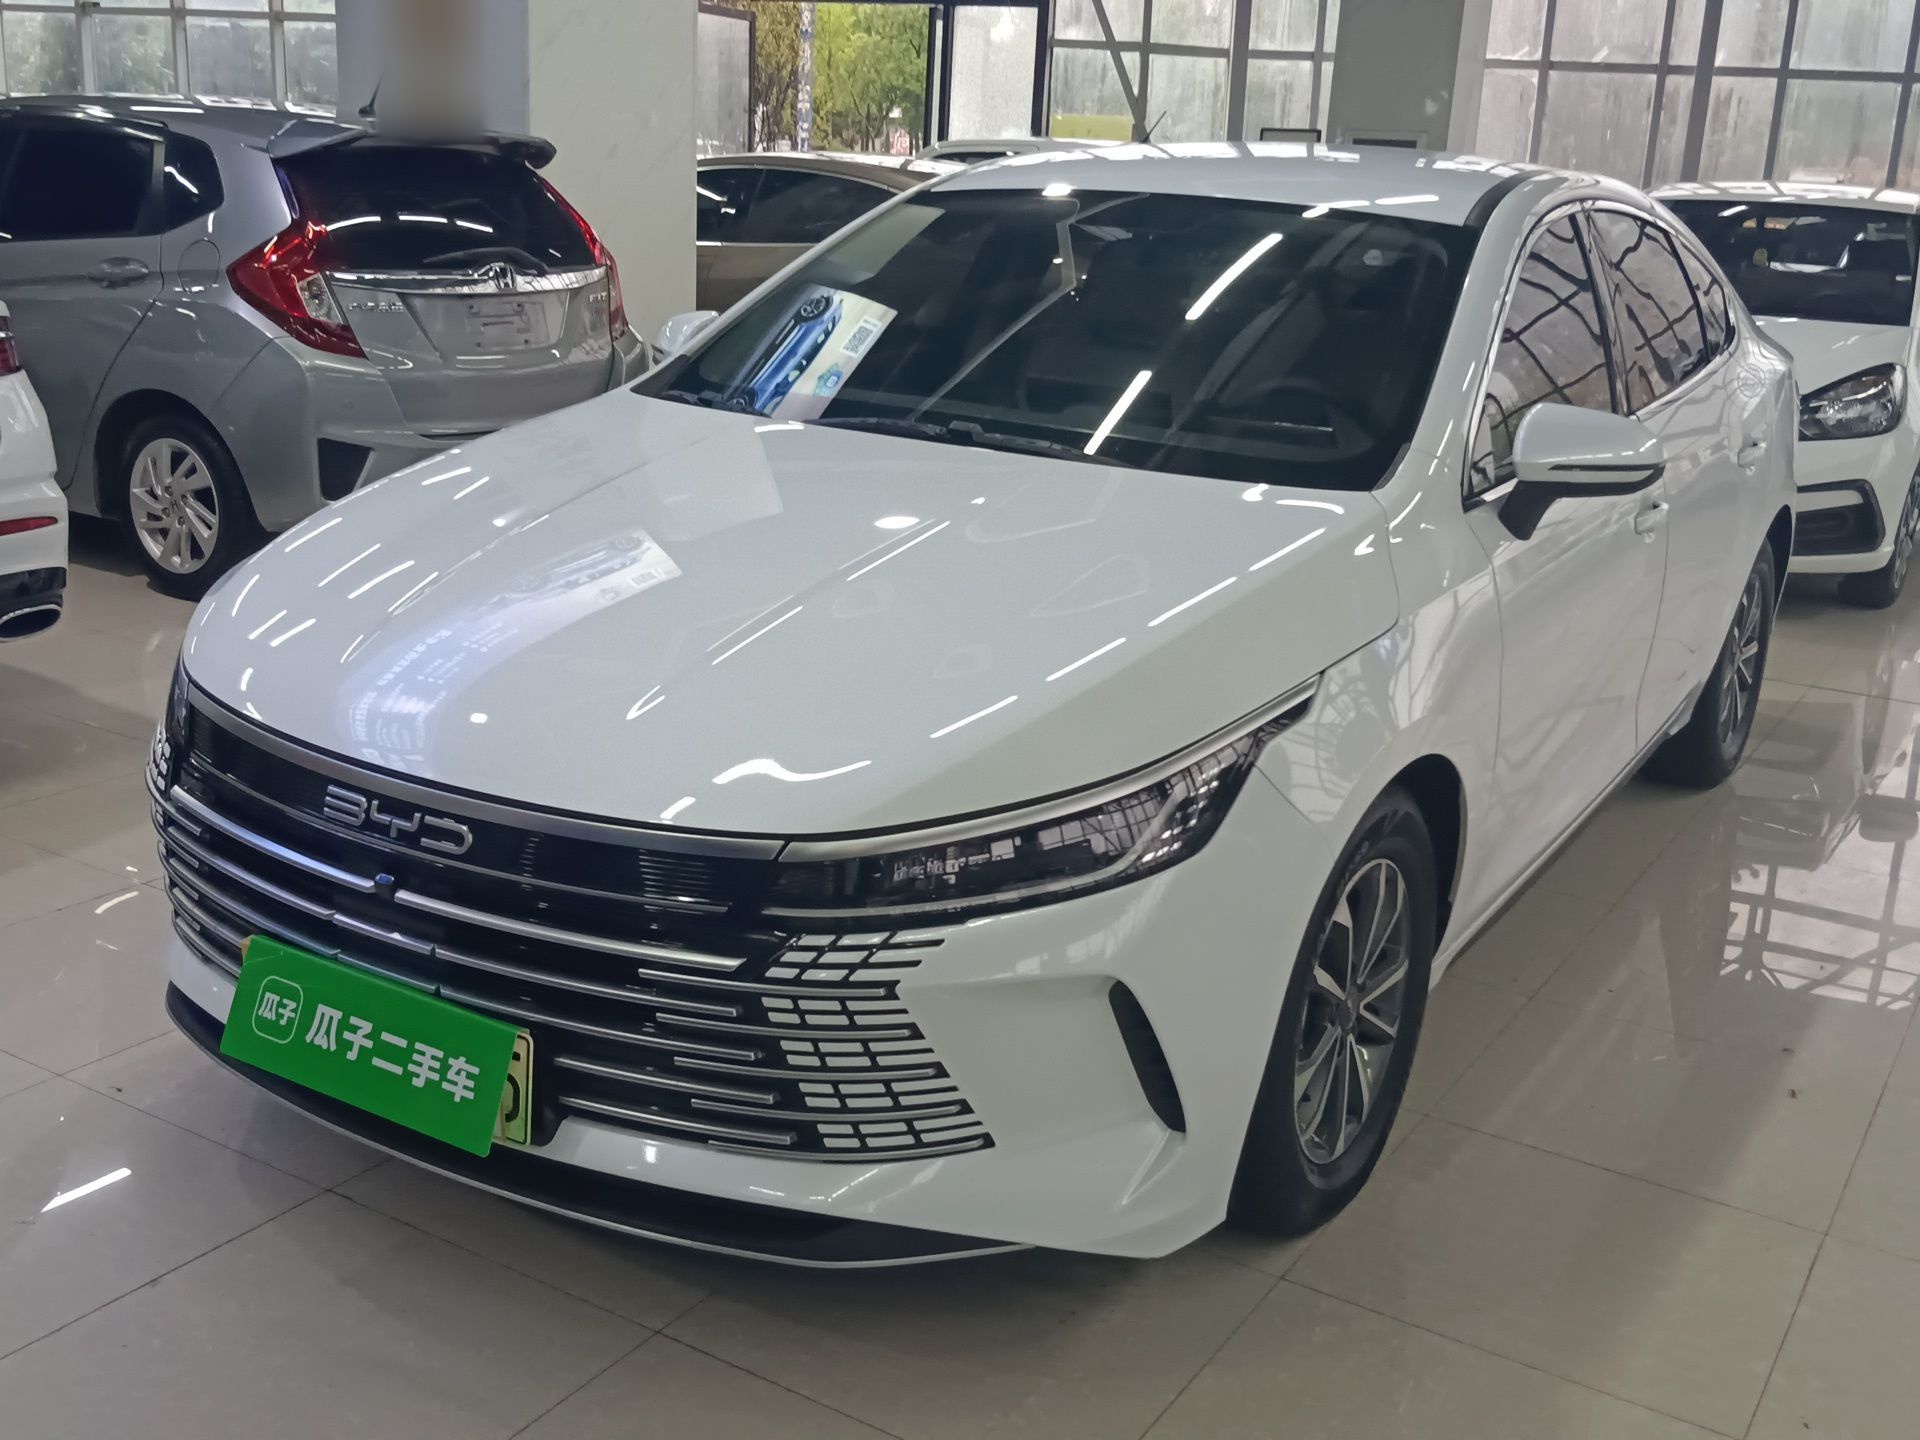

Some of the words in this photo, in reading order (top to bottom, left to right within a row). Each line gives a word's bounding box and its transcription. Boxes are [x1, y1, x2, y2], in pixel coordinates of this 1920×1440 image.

[589, 291, 607, 303] FIT
[324, 785, 473, 855] BYD
[258, 991, 297, 1026] 瓜子
[305, 1003, 480, 1103] 瓜子二手车
